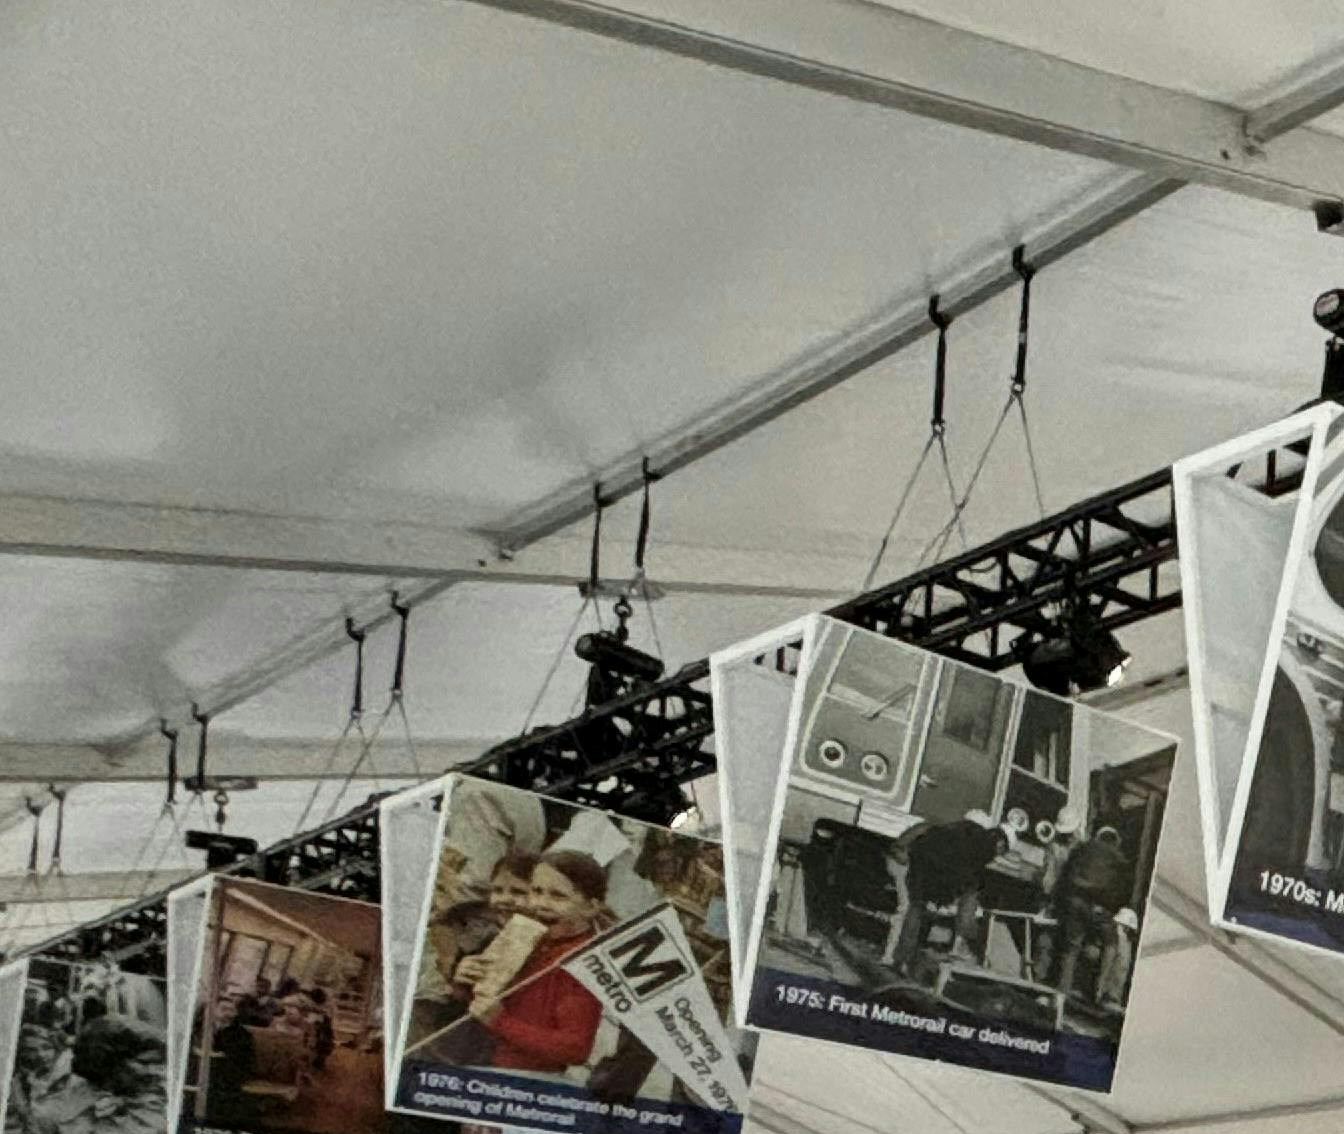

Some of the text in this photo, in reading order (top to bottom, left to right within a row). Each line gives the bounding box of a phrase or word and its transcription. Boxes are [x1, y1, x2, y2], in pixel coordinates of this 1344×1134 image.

[1260, 870, 1321, 907] 1970s:
[582, 953, 633, 1014] metro
[608, 925, 688, 997] M
[655, 1005, 694, 1058] March
[674, 997, 723, 1063] Opening
[776, 984, 1050, 1054] 1975: First Metrorail car delivered
[413, 1091, 577, 1126] opening of Metrorail
[466, 1079, 534, 1104] Children
[536, 1092, 610, 1116] celebrate
[612, 1104, 637, 1120] the
[639, 1109, 684, 1128] grand
